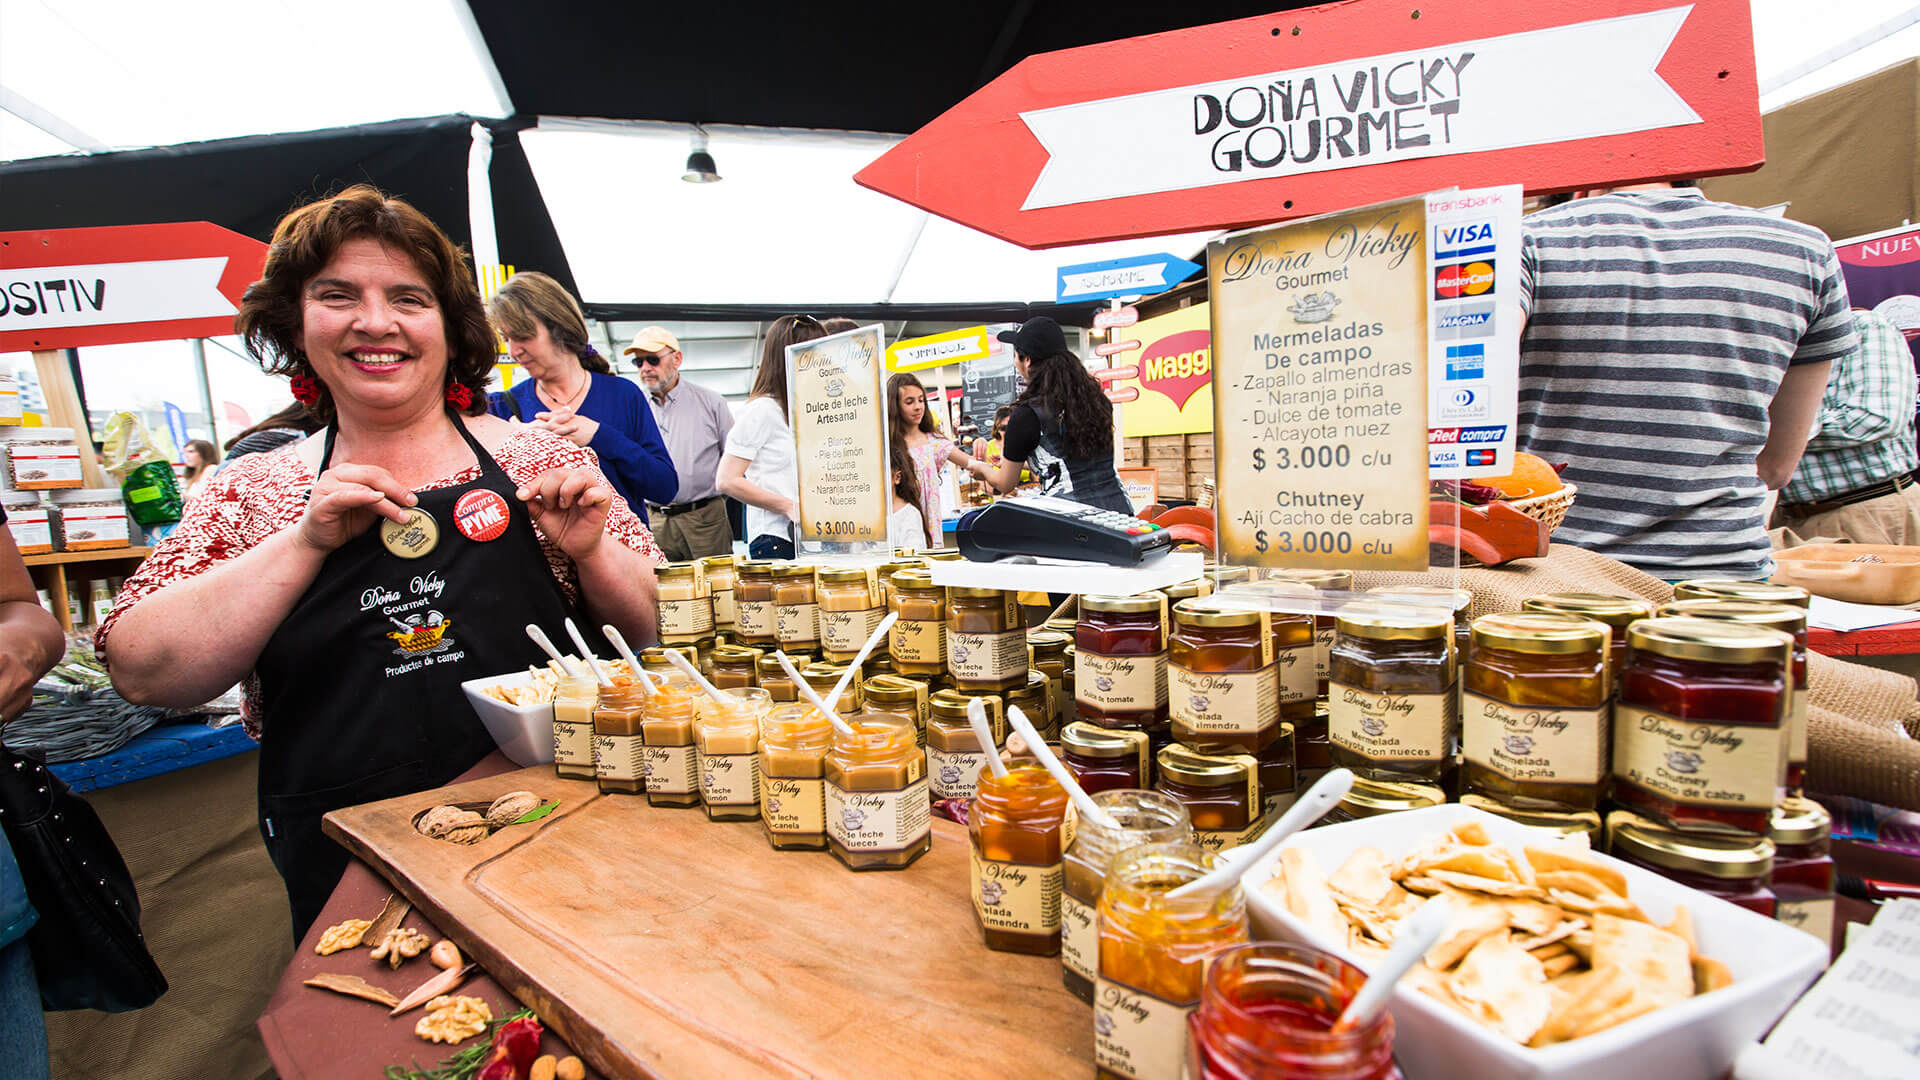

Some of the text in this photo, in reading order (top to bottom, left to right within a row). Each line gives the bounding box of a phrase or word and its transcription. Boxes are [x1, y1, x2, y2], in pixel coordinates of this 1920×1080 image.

[1194, 52, 1475, 135] DOÑA VICKY
[1211, 99, 1460, 172] GOURMET
[1428, 194, 1503, 213] transbank
[1441, 223, 1493, 244] VISA
[1222, 211, 1420, 283] Doña Vicky
[1276, 265, 1349, 291] Gourmet
[1436, 271, 1495, 289] MasterCard
[1440, 314, 1486, 328] MAGNA
[1253, 321, 1384, 351] Mermeladas
[1265, 344, 1373, 370] De campo
[1243, 361, 1413, 392] Zapallo almendras
[805, 394, 868, 414] Dulce de leche
[1269, 382, 1384, 406] Naranja piña
[816, 410, 857, 425] Artesanal
[1253, 400, 1403, 425] Dulce de tomate
[1263, 423, 1390, 443] Alcayota nuez
[1460, 429, 1505, 442] compra
[843, 446, 864, 457] limón
[1252, 444, 1392, 472] $ 3.000 c/u
[1434, 452, 1457, 462] VISA
[825, 472, 859, 483] Mapuche
[816, 482, 871, 497] Naranja canela
[455, 494, 496, 518] Compra
[829, 496, 857, 505] Nueces
[1277, 490, 1365, 511] Chutney
[460, 502, 506, 536] PYME
[816, 520, 871, 535] $ 3.000 c/u
[1269, 510, 1325, 526] Cacho
[1331, 510, 1353, 526] de
[1359, 510, 1414, 526] cabra
[1255, 529, 1393, 555] $ 3.000 c/u
[360, 570, 446, 611] Doña Vicky
[382, 597, 430, 615] Gourmet
[900, 621, 923, 635] Vicky
[957, 634, 984, 650] Vicky
[385, 650, 465, 678] Productos de campo
[963, 662, 983, 671] leche
[1105, 657, 1135, 677] Vicky
[1199, 673, 1234, 695] Vicky
[1106, 694, 1135, 703] tomate
[1377, 694, 1416, 717] Vicky
[1483, 702, 1569, 736] Doña Vicky
[1351, 730, 1400, 746] Mermelada
[646, 746, 670, 762] Vicky
[949, 753, 977, 768] Vicky
[1367, 747, 1386, 756] con
[1390, 747, 1431, 757] nueces
[1492, 748, 1550, 767] Mermelada
[706, 756, 733, 772] Vicky
[772, 778, 801, 798] Vicky
[955, 782, 976, 790] leche
[1655, 767, 1709, 789] Chutney
[711, 786, 732, 794] leche
[1646, 777, 1680, 795] cacho
[1683, 786, 1700, 798] de
[1704, 787, 1746, 802] cabra
[850, 791, 886, 811] Vicky
[777, 813, 799, 822] leche
[848, 840, 878, 848] ueces
[858, 830, 884, 838] leche
[986, 863, 1028, 887] Vicky
[984, 906, 1012, 918] elada
[1062, 898, 1092, 929] Vicky
[1103, 985, 1150, 1023] Vicky
[1096, 1038, 1131, 1058] elada
[1097, 1053, 1137, 1075] a-piña
